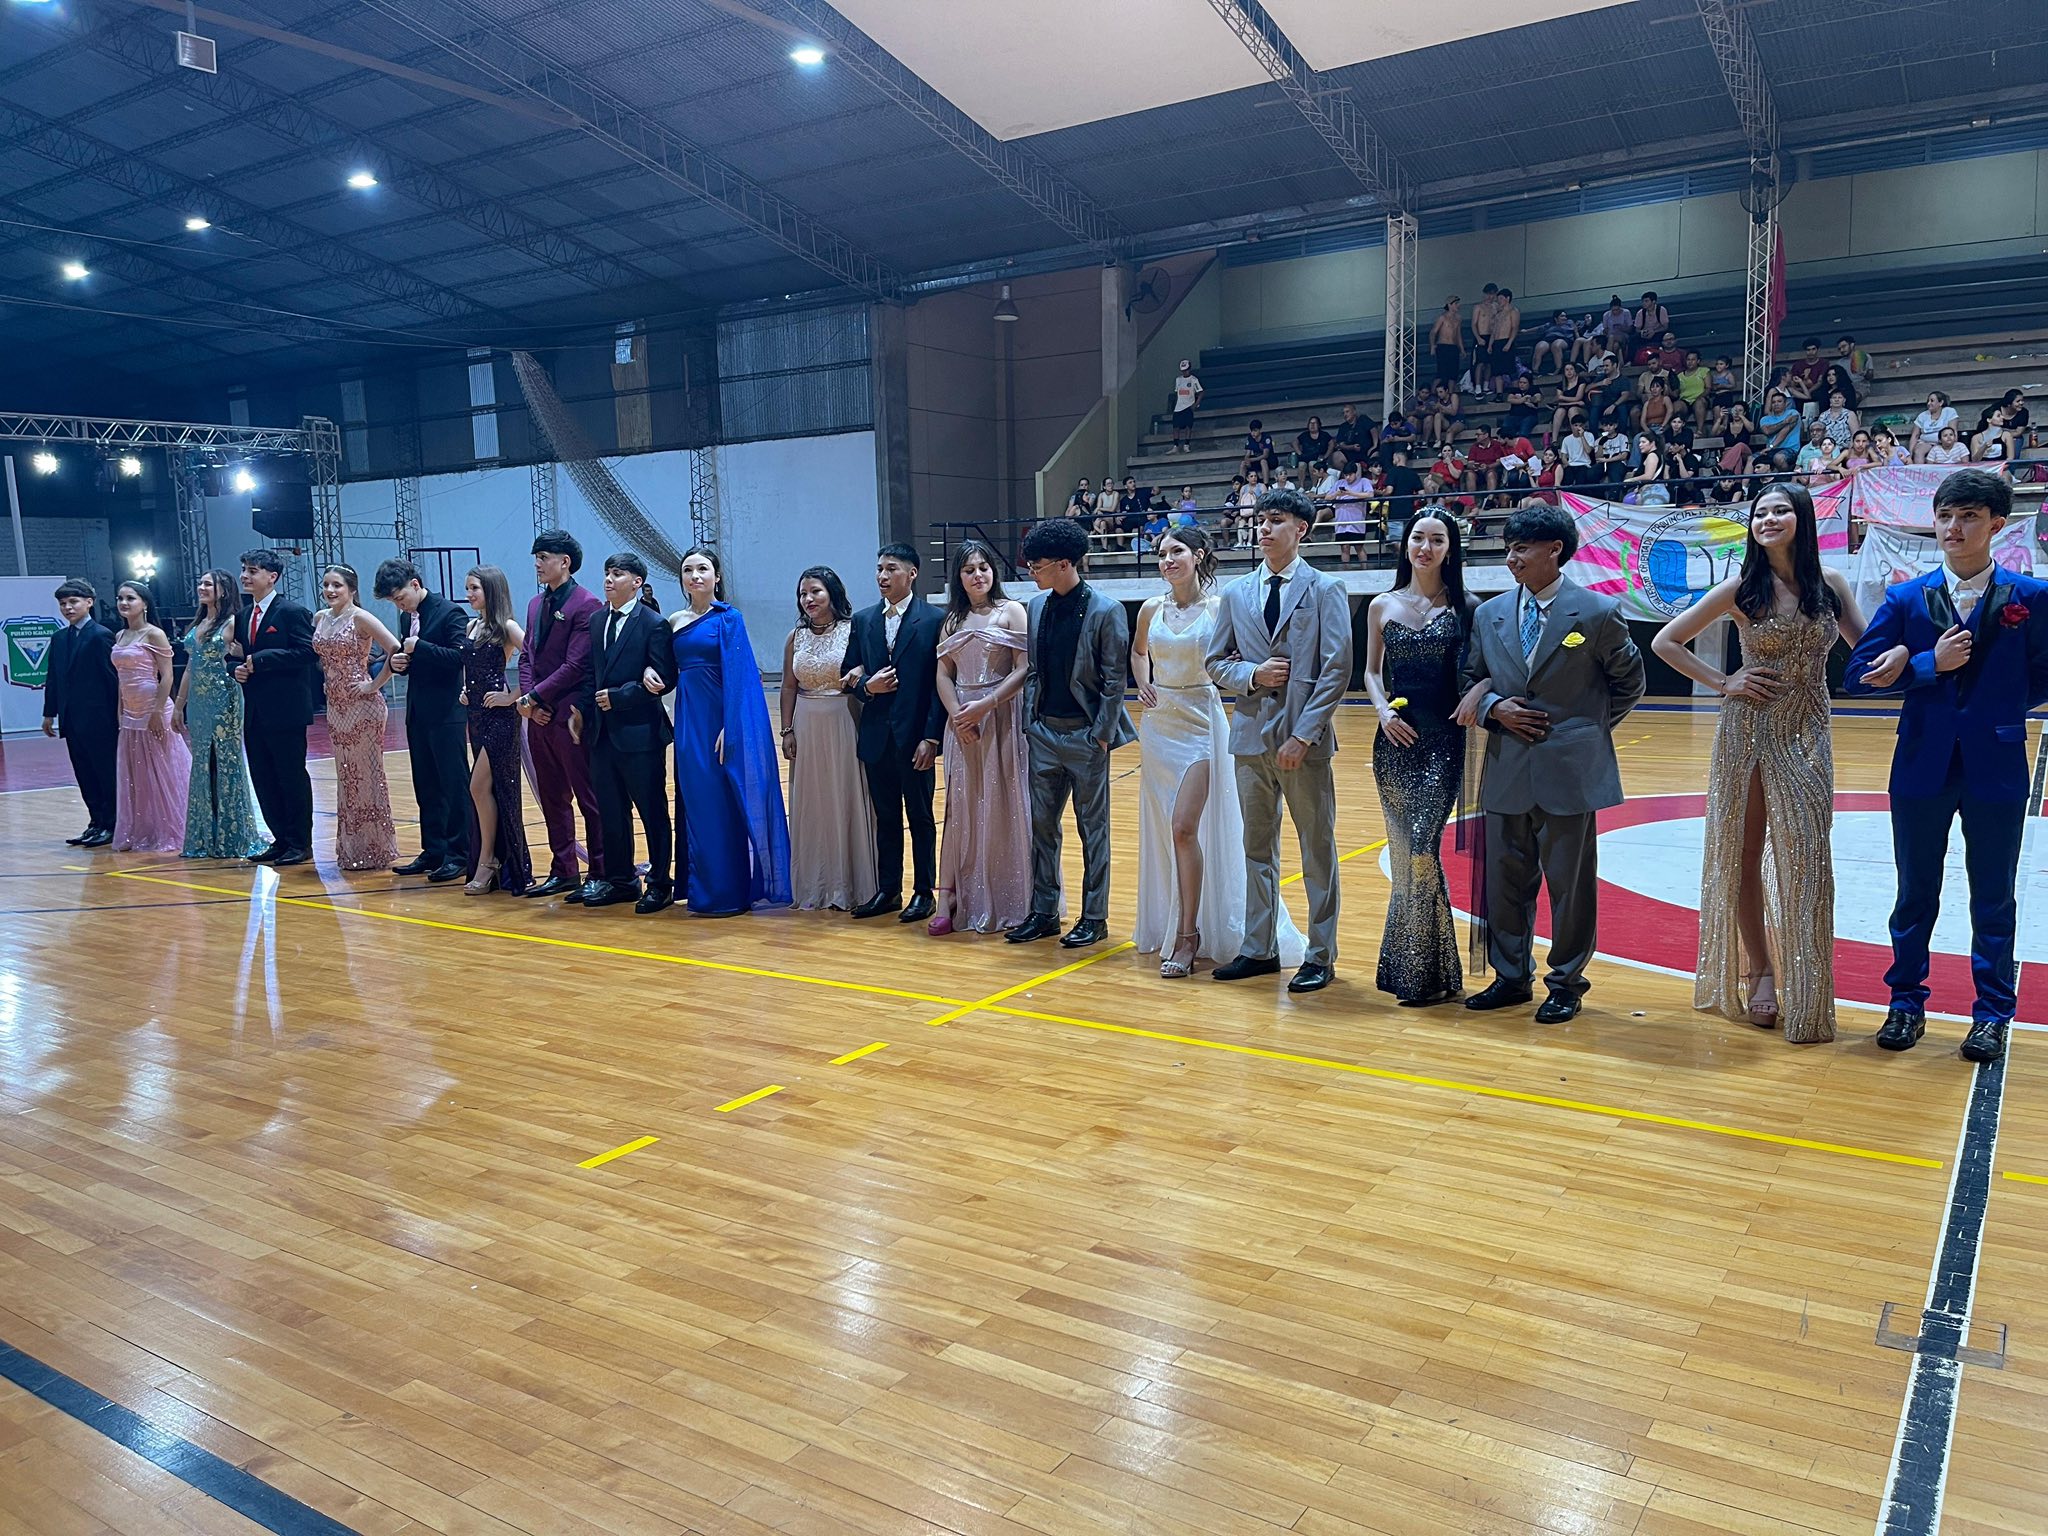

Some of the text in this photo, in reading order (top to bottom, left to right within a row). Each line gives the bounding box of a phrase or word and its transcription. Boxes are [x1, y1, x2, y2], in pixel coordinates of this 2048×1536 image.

[1639, 536, 1655, 573] ORIENTADO
[1650, 509, 1697, 535] PROVINCIAL
[1713, 508, 1728, 517] 23
